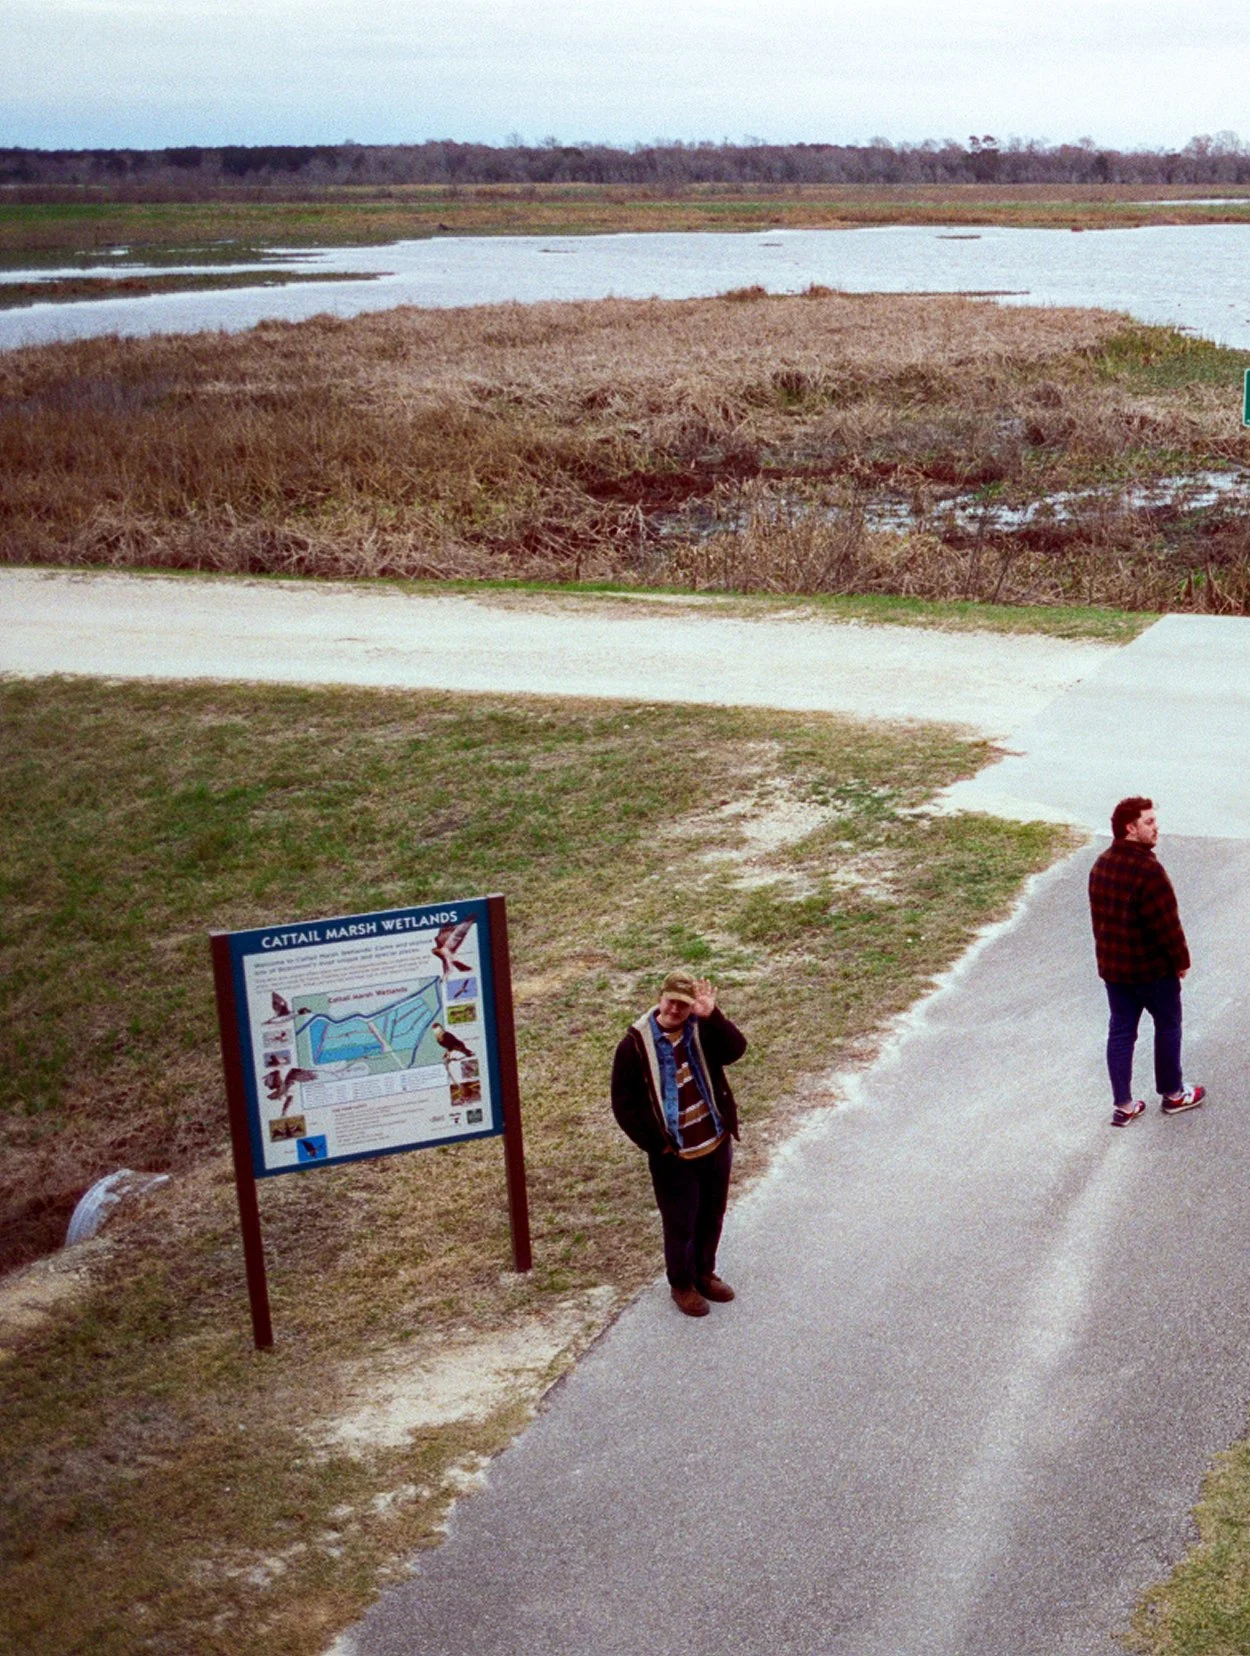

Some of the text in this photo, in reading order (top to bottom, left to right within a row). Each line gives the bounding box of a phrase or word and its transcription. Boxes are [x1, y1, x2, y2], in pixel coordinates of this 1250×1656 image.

[261, 911, 458, 948] CATTAIL MARSH WETLANDS
[328, 986, 408, 1004] Cattail Marsh Wetlands
